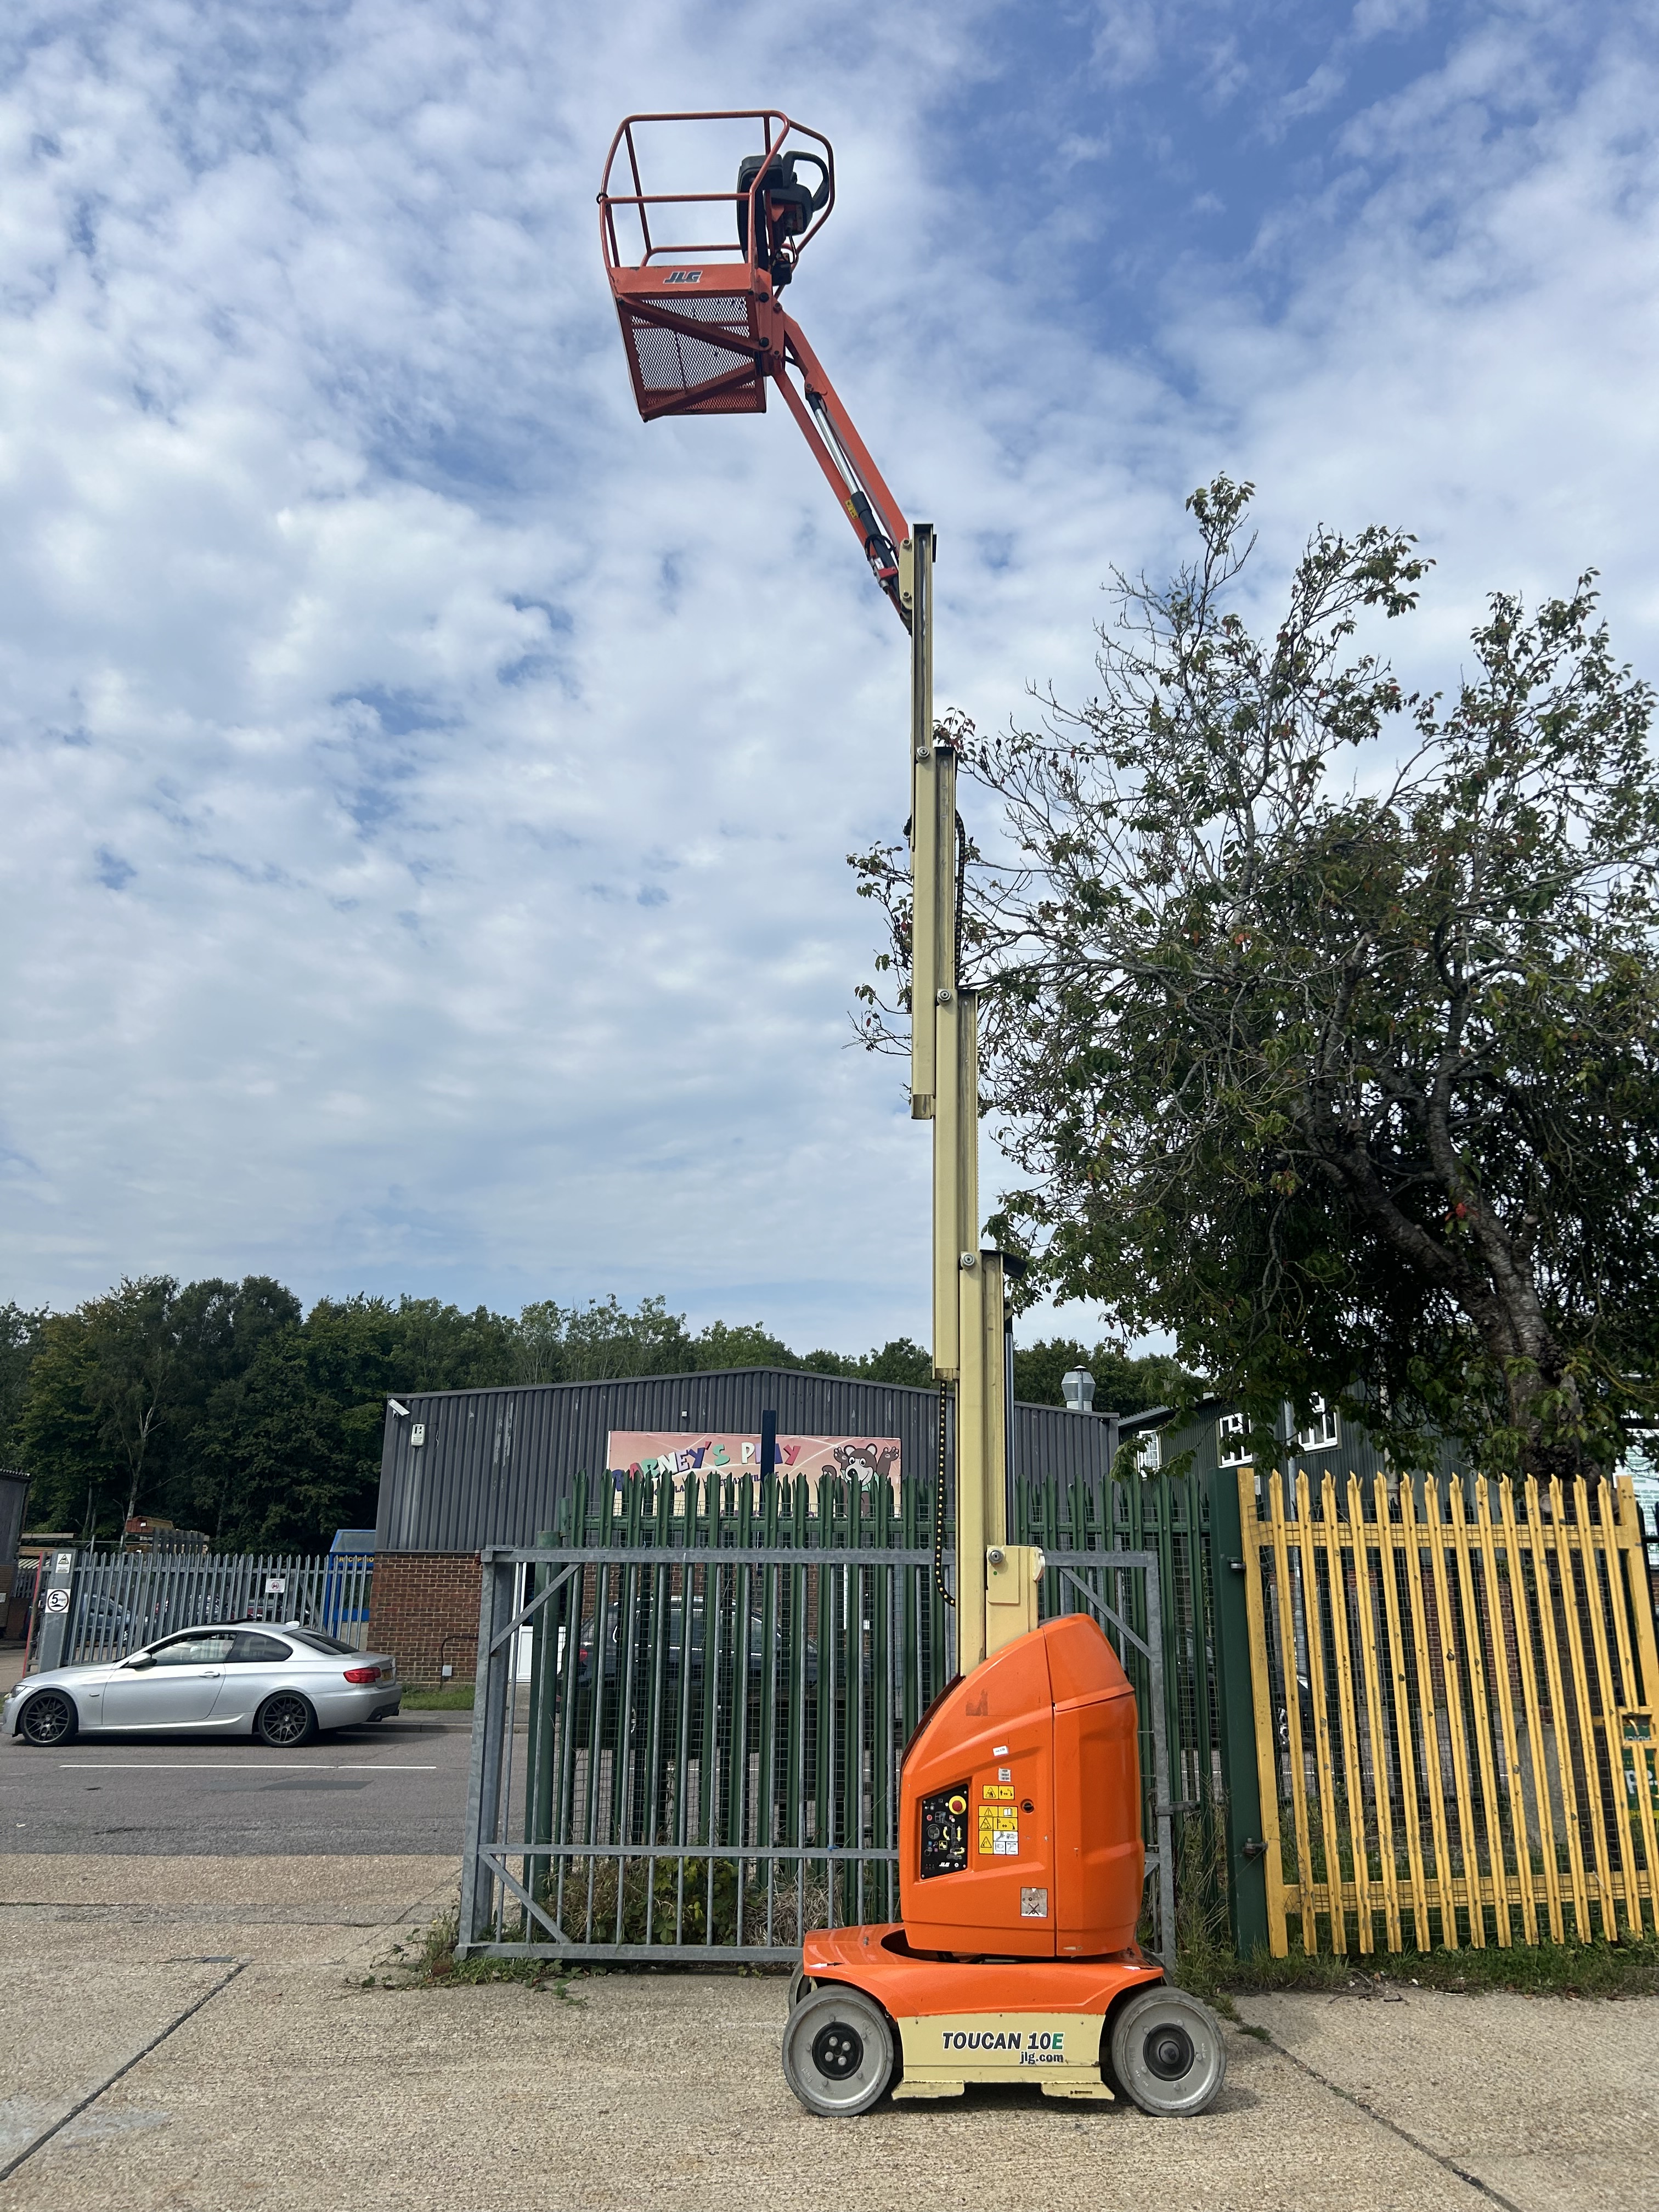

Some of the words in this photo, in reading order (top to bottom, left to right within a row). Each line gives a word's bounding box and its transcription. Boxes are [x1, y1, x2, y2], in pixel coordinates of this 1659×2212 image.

[663, 270, 702, 284] JLG
[52, 1594, 59, 1604] 5
[942, 2032, 1021, 2050] TOUCAN
[1028, 2032, 1065, 2050] 10E
[1020, 2051, 1064, 2064] jlg.com
